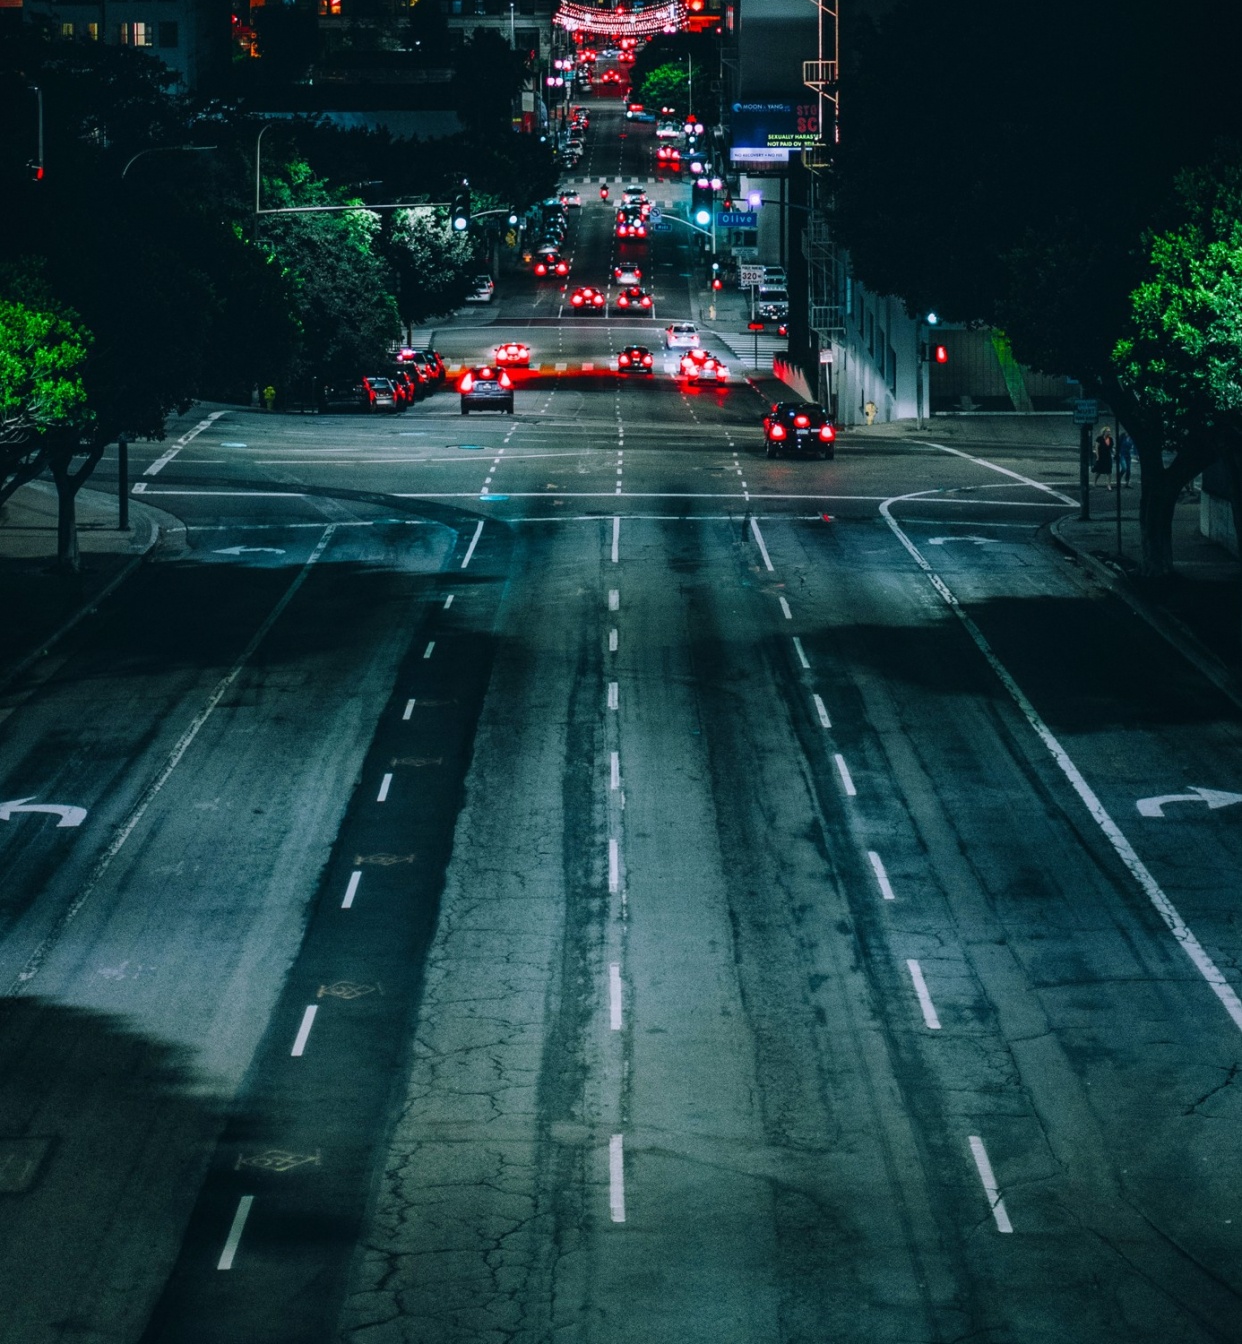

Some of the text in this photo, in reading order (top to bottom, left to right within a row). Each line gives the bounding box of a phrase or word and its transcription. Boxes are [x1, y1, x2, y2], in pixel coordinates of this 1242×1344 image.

[796, 105, 817, 116] STO
[797, 117, 817, 133] SC
[722, 215, 752, 223] Olive
[742, 272, 757, 280] 320
